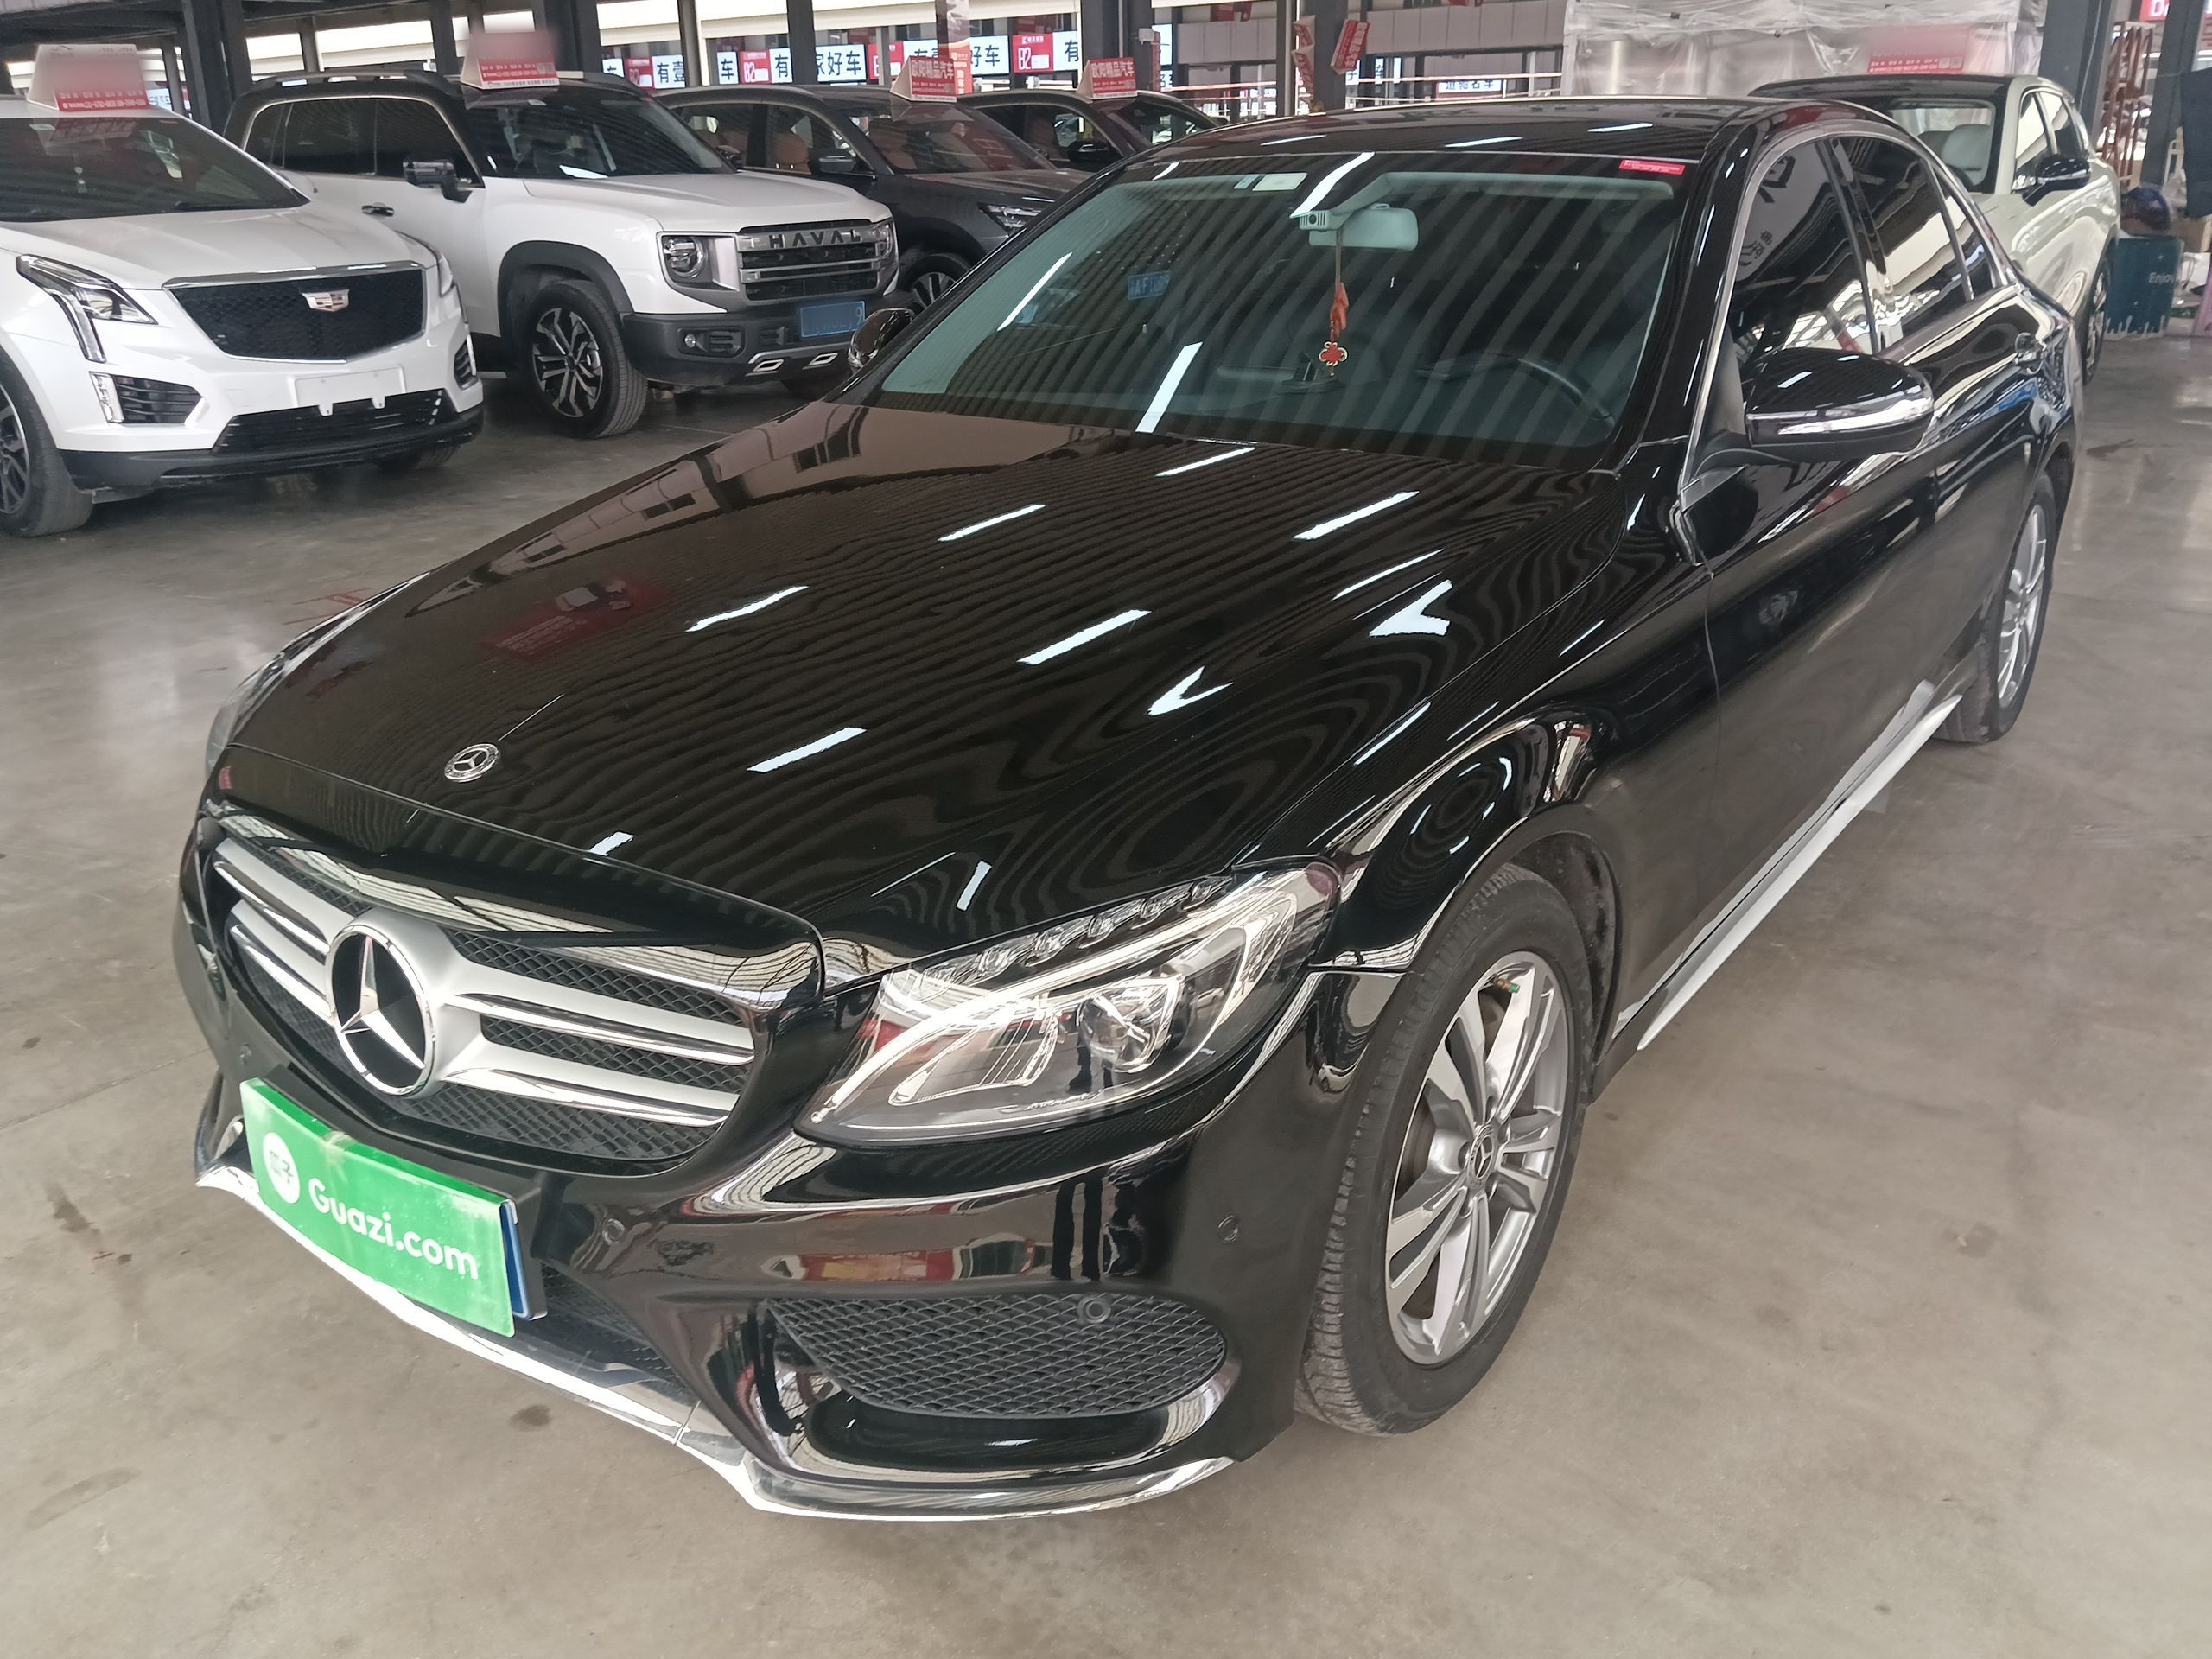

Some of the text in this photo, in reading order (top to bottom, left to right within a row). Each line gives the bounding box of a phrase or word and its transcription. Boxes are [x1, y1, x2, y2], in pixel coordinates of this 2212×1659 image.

[775, 54, 789, 78] 有
[769, 229, 861, 249] HAVAL
[308, 1178, 479, 1280] Guazi.com
